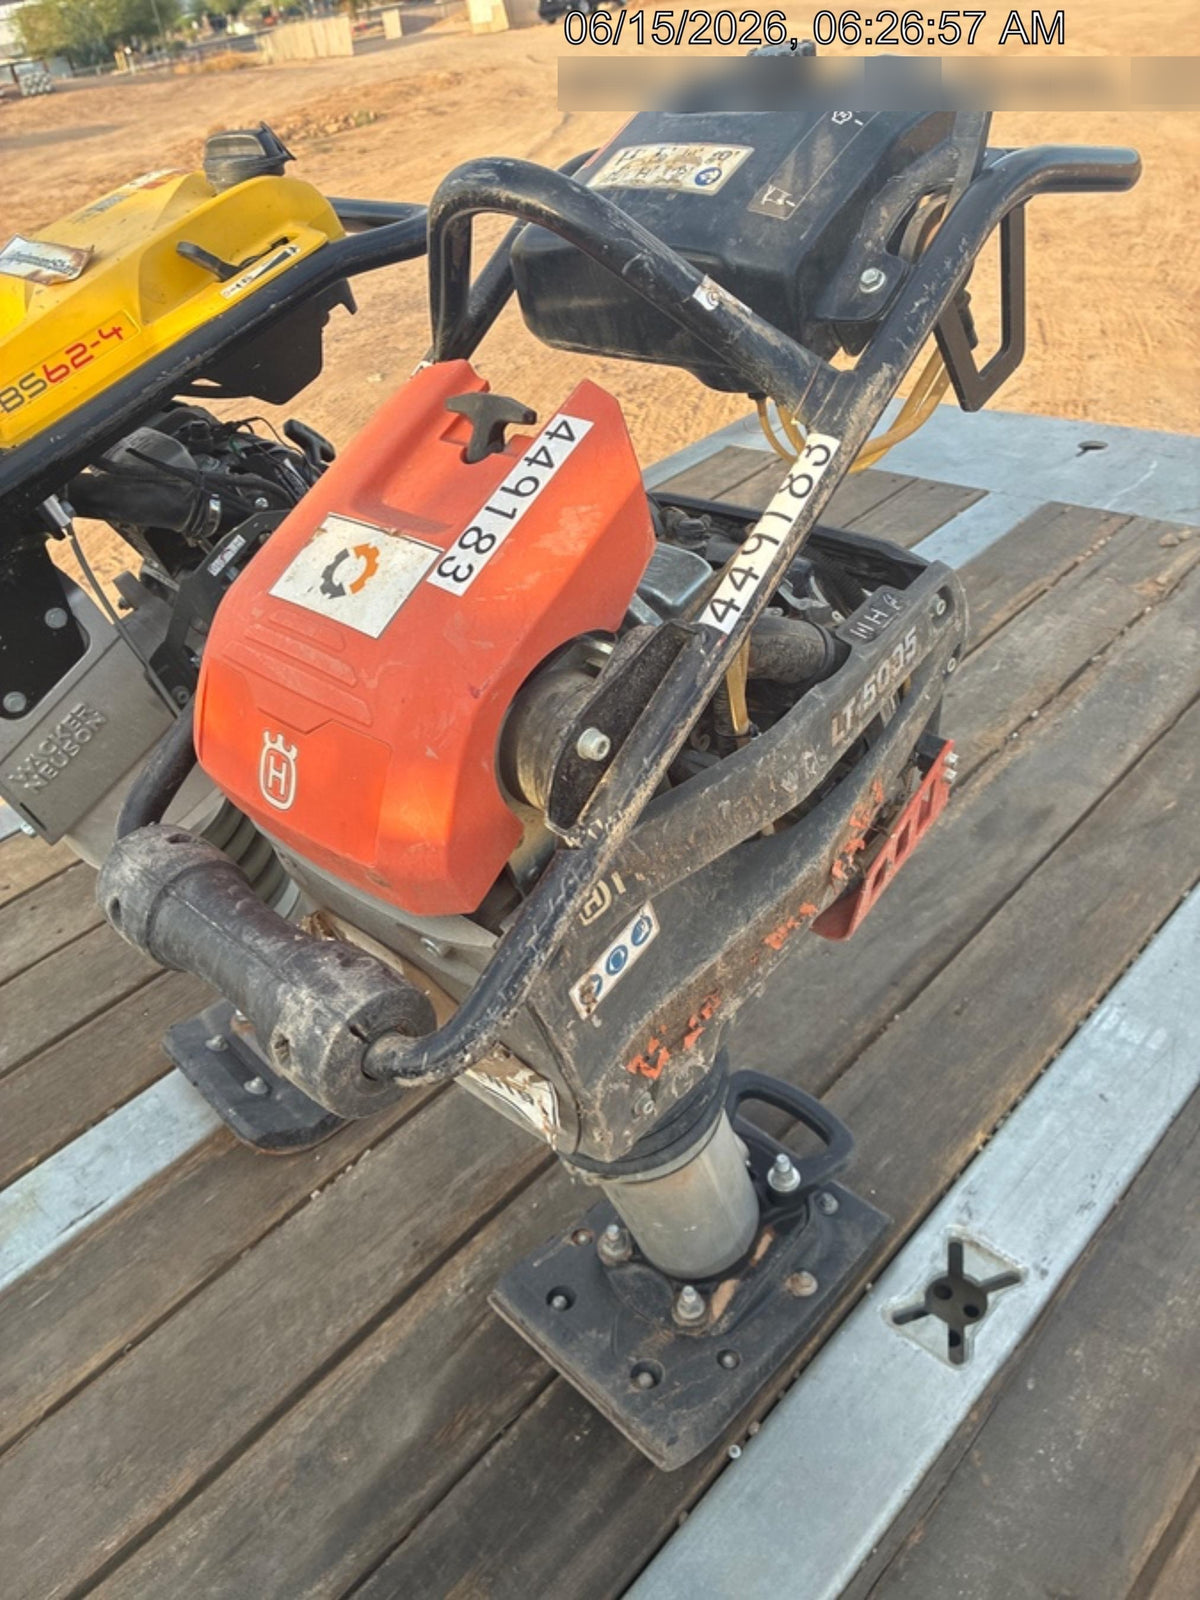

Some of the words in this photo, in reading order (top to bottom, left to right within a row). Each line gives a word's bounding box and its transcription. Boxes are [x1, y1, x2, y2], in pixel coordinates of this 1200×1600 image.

[437, 420, 576, 583] 449183
[710, 444, 831, 622] 449183
[8, 702, 89, 783] WACKER
[24, 711, 106, 793] NEUSON
